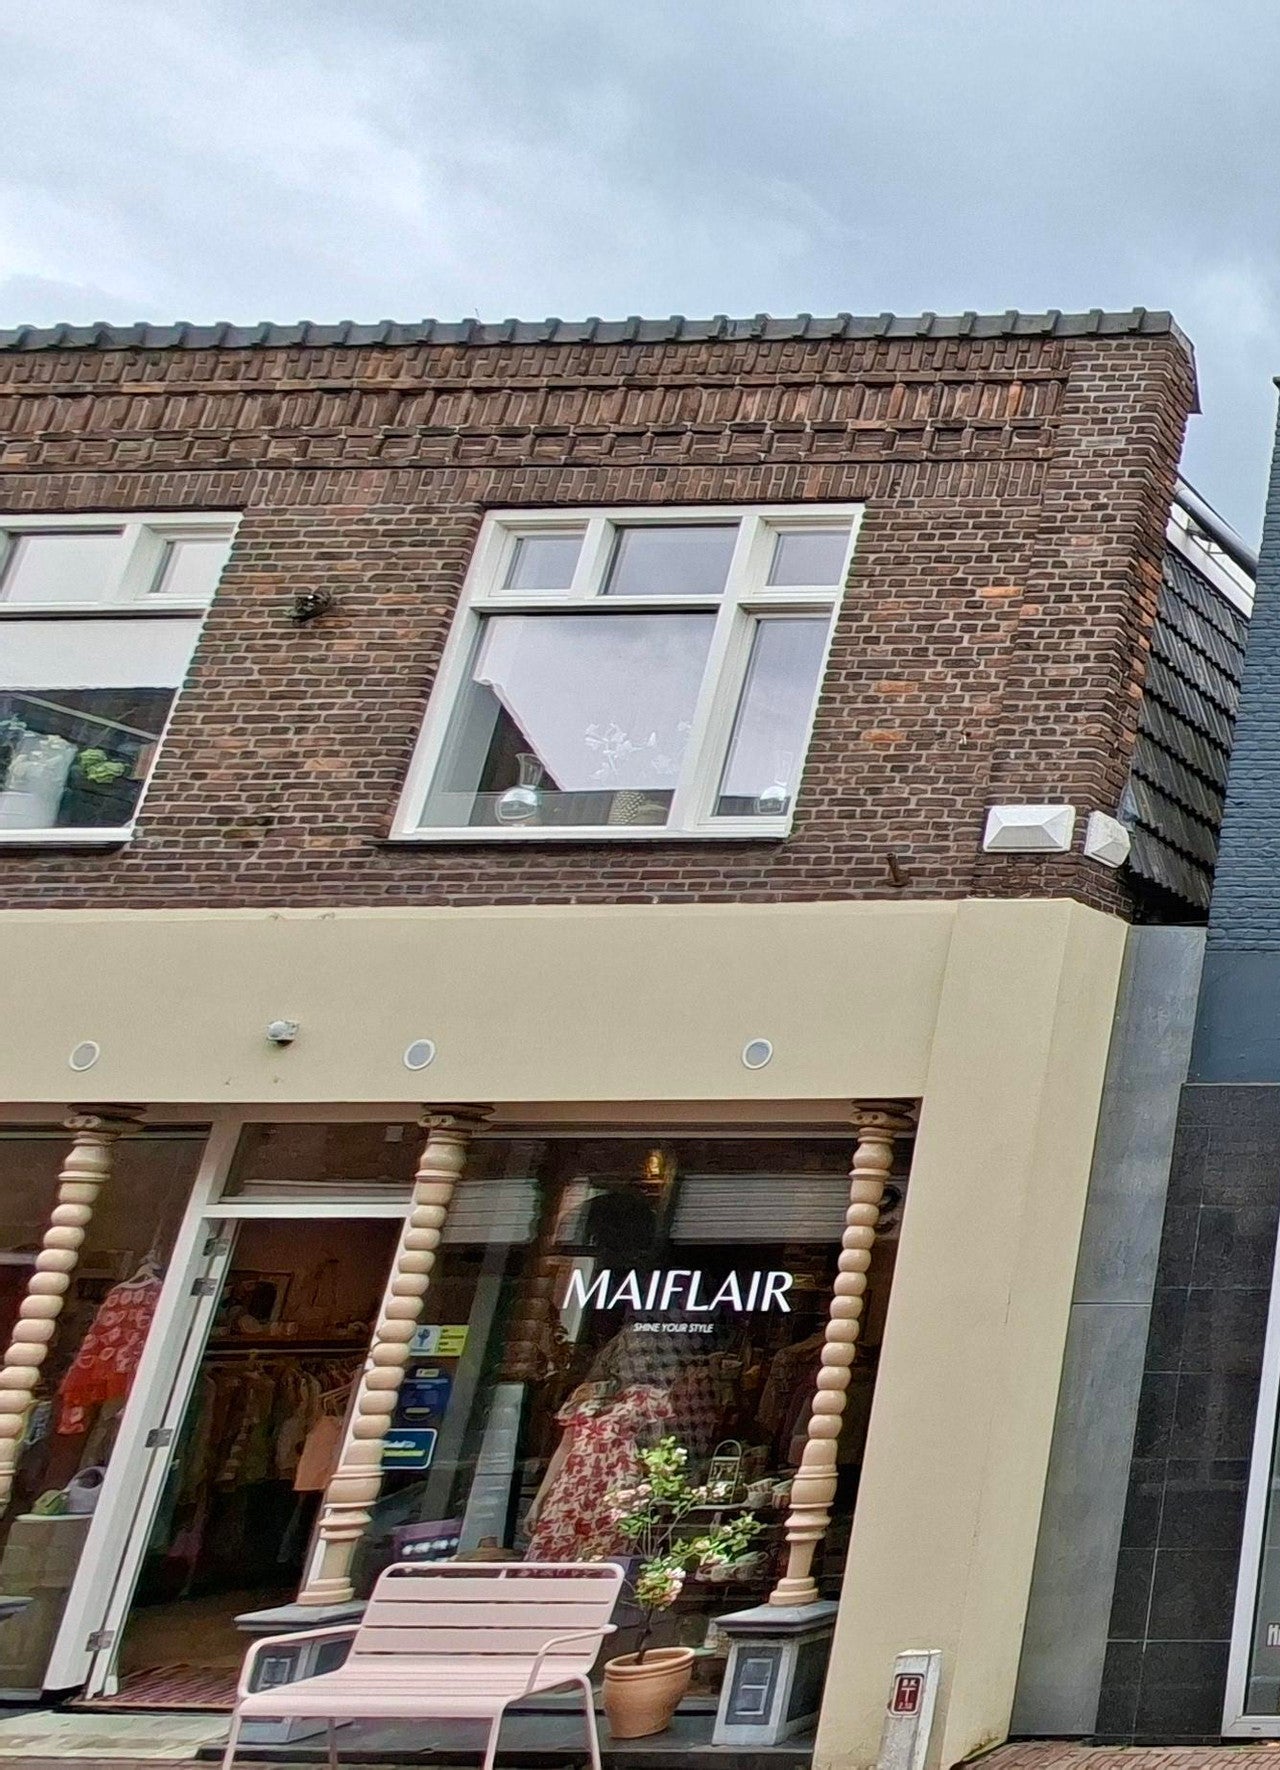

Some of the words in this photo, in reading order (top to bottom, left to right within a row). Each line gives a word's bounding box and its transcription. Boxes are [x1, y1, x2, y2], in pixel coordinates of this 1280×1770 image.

[562, 1268, 794, 1313] MAIFLAIR
[633, 1322, 660, 1333] SHINE
[662, 1322, 688, 1333] YOUR
[688, 1322, 715, 1333] STYLE
